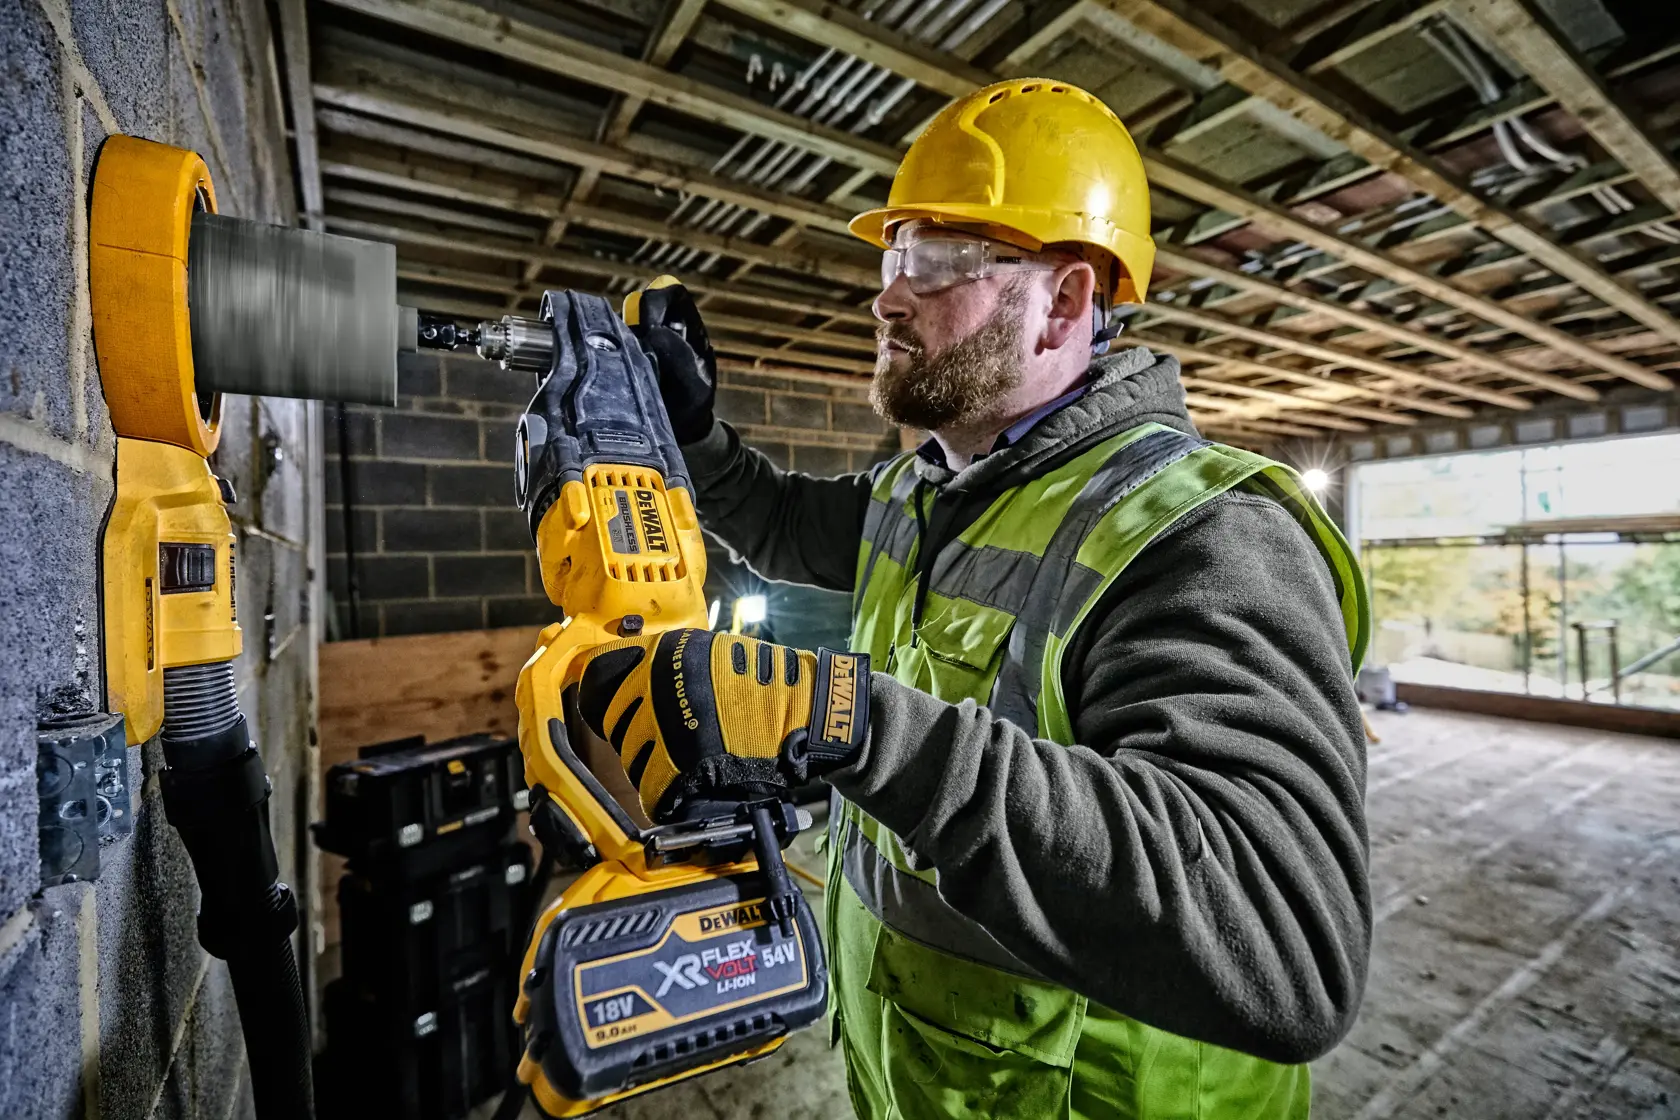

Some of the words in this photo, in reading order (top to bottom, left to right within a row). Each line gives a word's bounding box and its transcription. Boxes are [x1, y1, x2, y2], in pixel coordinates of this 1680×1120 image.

[618, 497, 637, 552] BRUSHLESS
[636, 490, 667, 552] DEWALT
[672, 628, 694, 670] ANTEED
[827, 655, 854, 743] DEWALT
[701, 939, 756, 968] FLEX
[704, 954, 758, 980] VOLT
[762, 942, 796, 968] 54V
[653, 953, 709, 998] XR
[717, 971, 756, 994] LI-ION
[593, 994, 634, 1024] 18V
